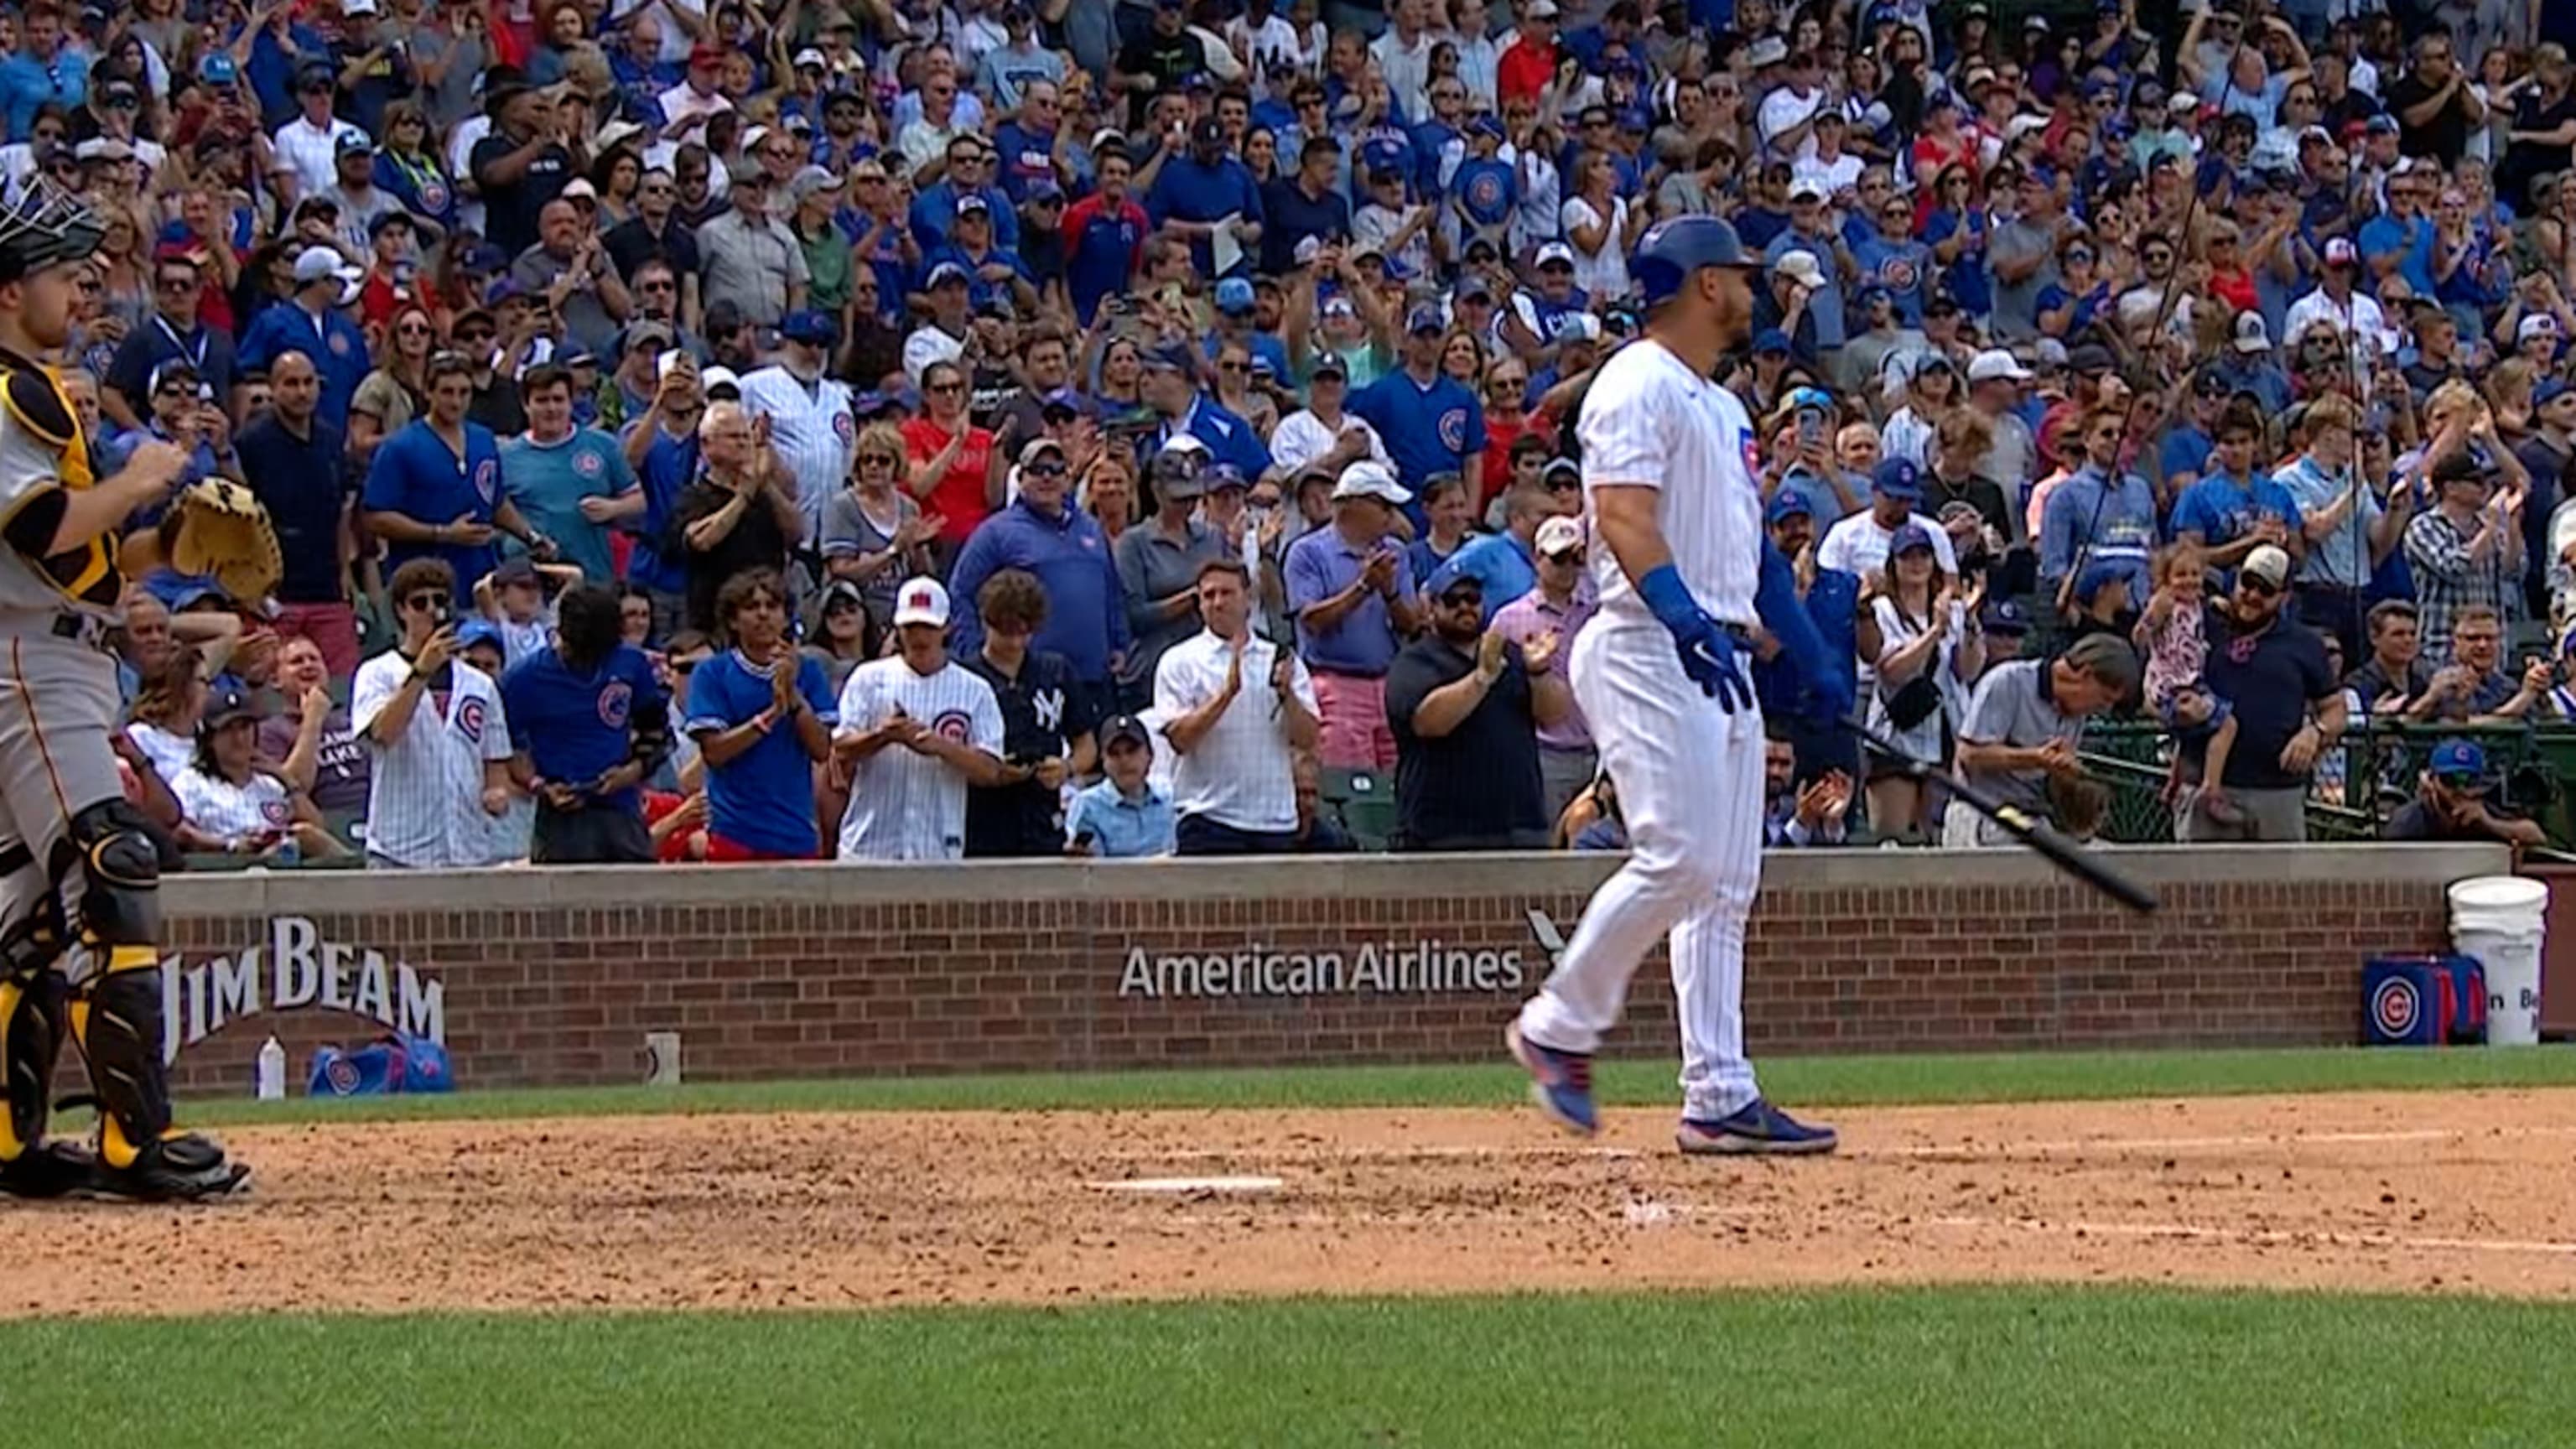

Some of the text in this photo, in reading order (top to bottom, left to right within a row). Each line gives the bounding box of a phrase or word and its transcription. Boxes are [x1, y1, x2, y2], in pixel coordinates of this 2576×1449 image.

[161, 917, 444, 1069] JIM BEAM
[1119, 939, 1523, 997] American Airlines
